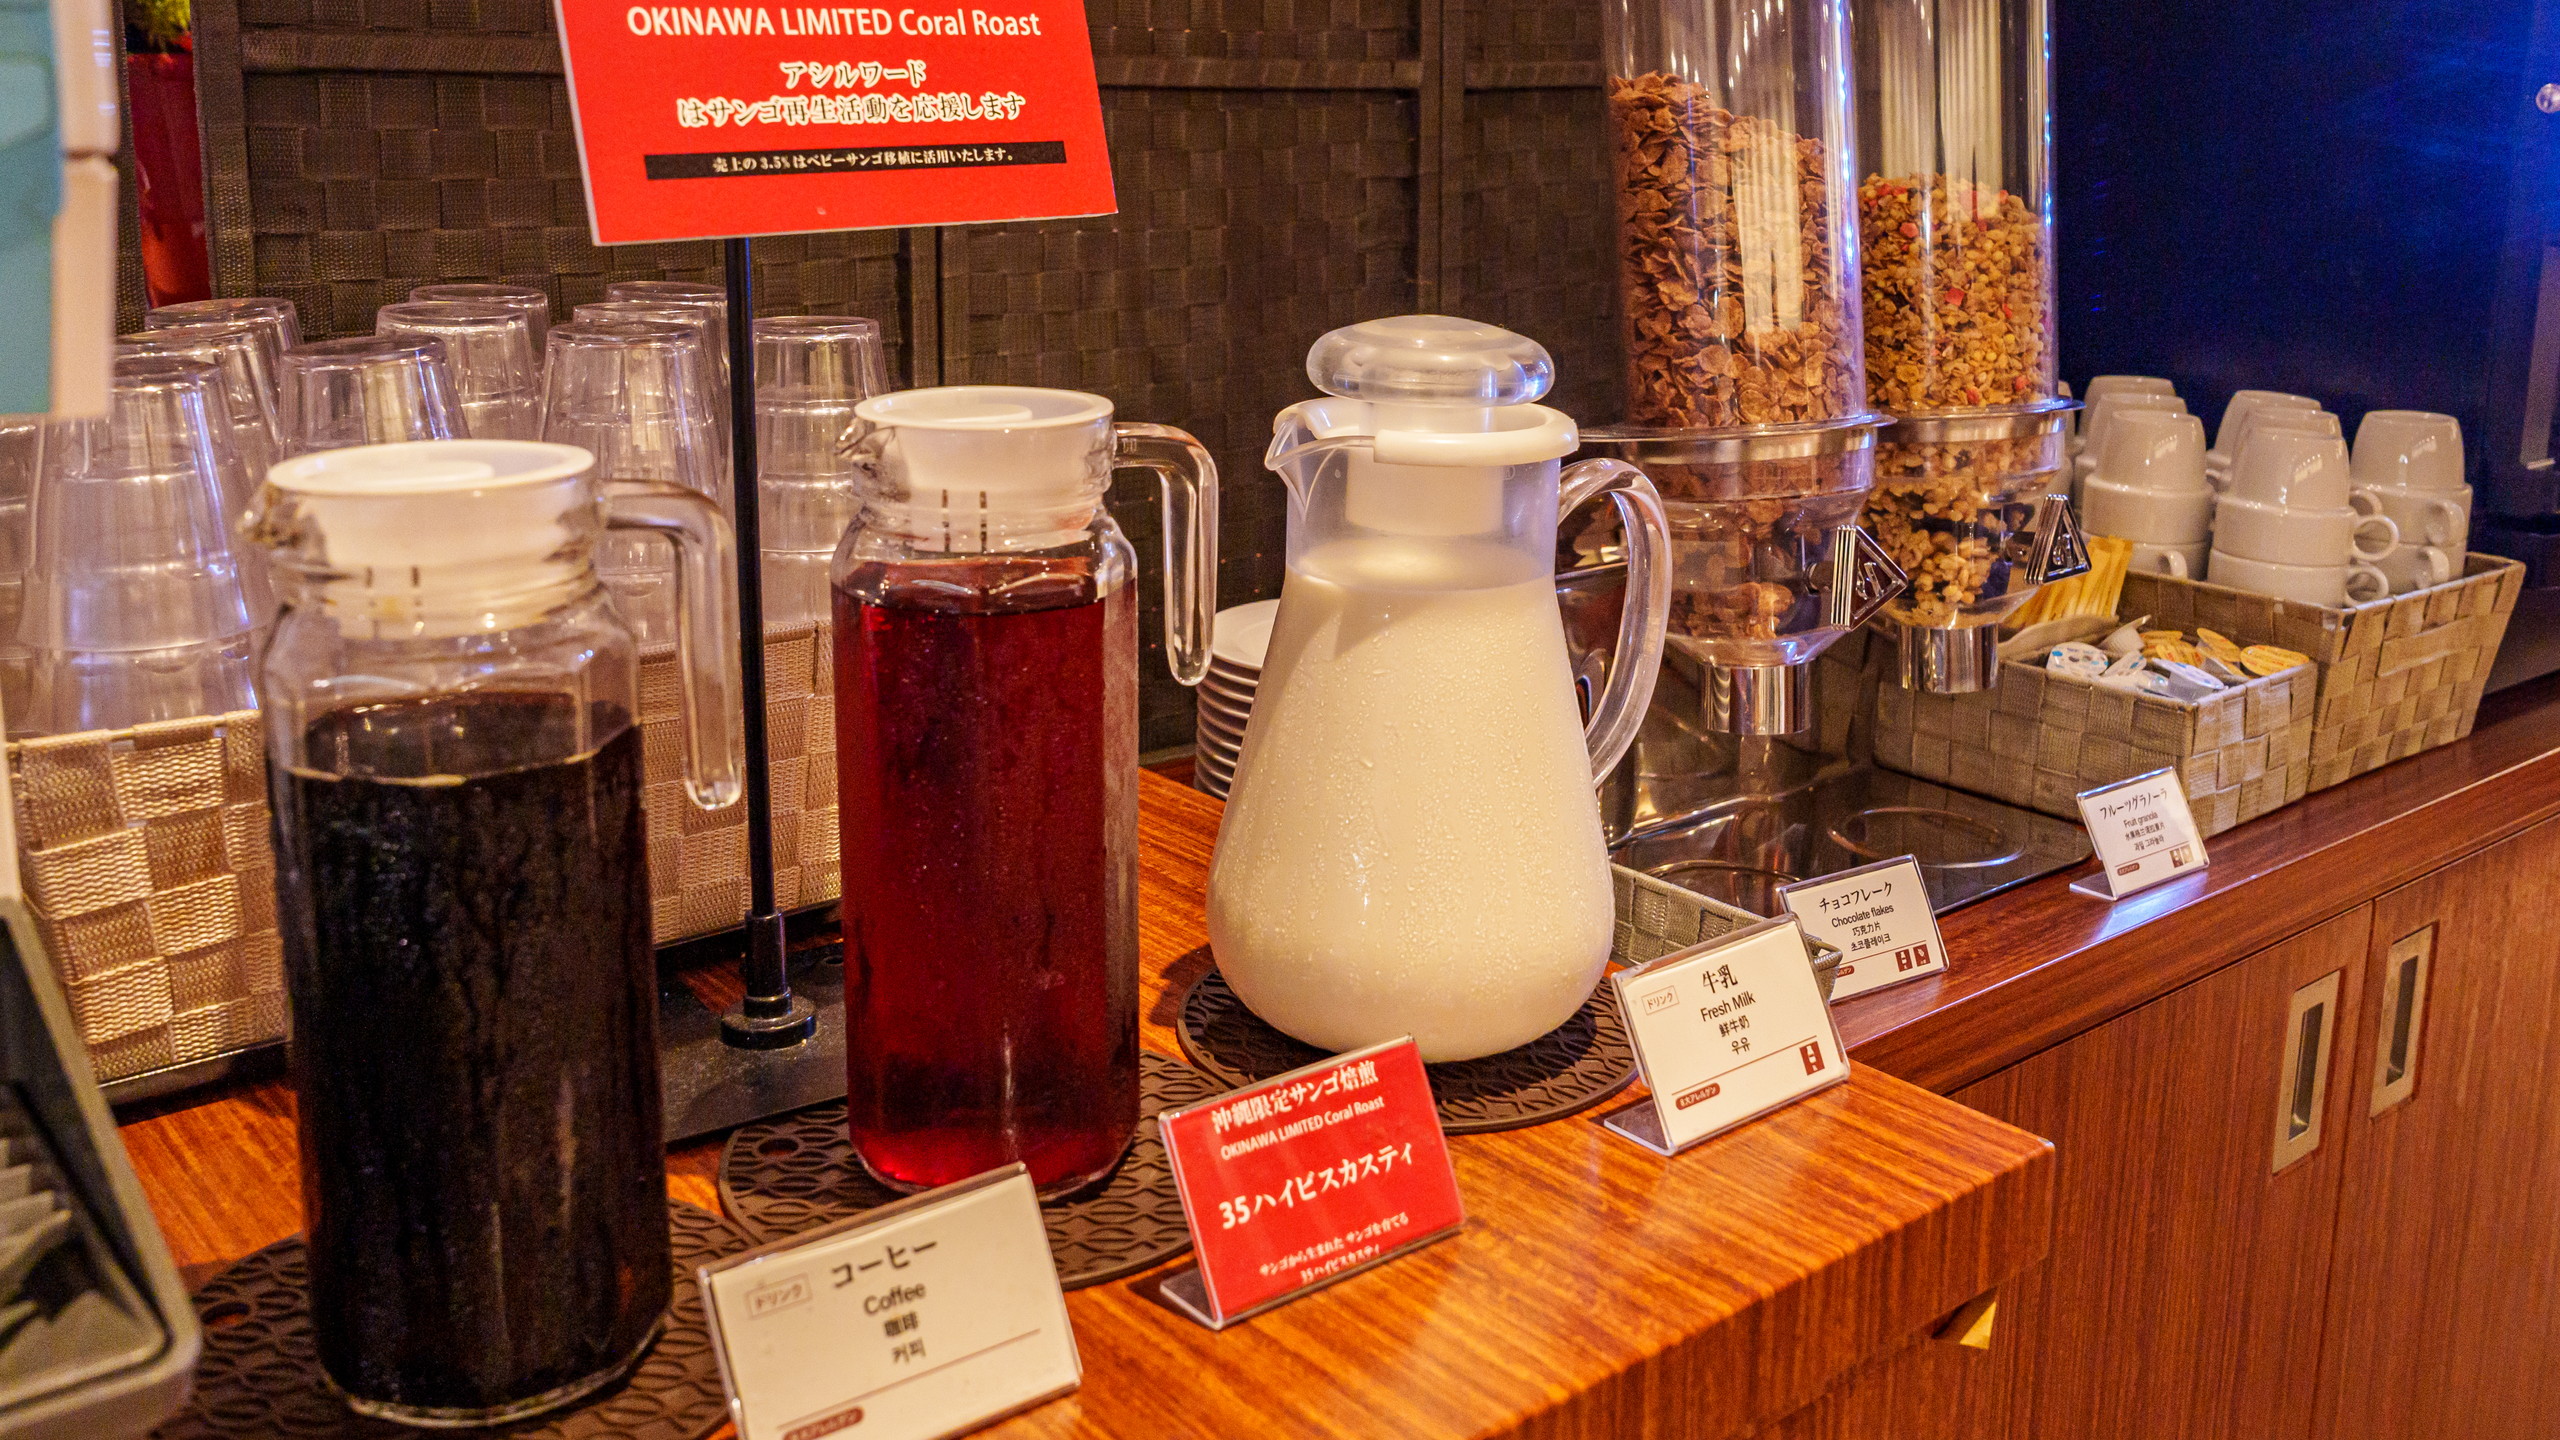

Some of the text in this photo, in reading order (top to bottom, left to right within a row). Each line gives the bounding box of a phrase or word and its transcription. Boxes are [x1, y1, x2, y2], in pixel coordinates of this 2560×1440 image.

[627, 6, 1042, 36] OKINAWA LIMITED Coral Roast
[780, 59, 927, 89] アシルワード
[676, 91, 1026, 128] はサンゴ再生活動を応援します
[2100, 788, 2168, 819] フルーツグラノーラ
[2124, 818, 2137, 828] Fruit
[1819, 881, 1893, 914] チョコフレーク
[1831, 904, 1893, 927] Chocolate flakes
[1852, 922, 1881, 936] 巧克力片
[1851, 934, 1891, 951] 초코플레이크
[1702, 964, 1739, 994] 牛乳
[1646, 991, 1674, 1011] ドリンク
[1700, 991, 1757, 1023] Fresh Milk
[1731, 1036, 1751, 1055] 우유
[1211, 1059, 1379, 1135] 沖縄限定サンゴ焙煎
[1219, 1095, 1385, 1161] OKINAWA LIMITED Coral Roast
[831, 1240, 938, 1290] コーヒー
[863, 1282, 927, 1316] Coffee
